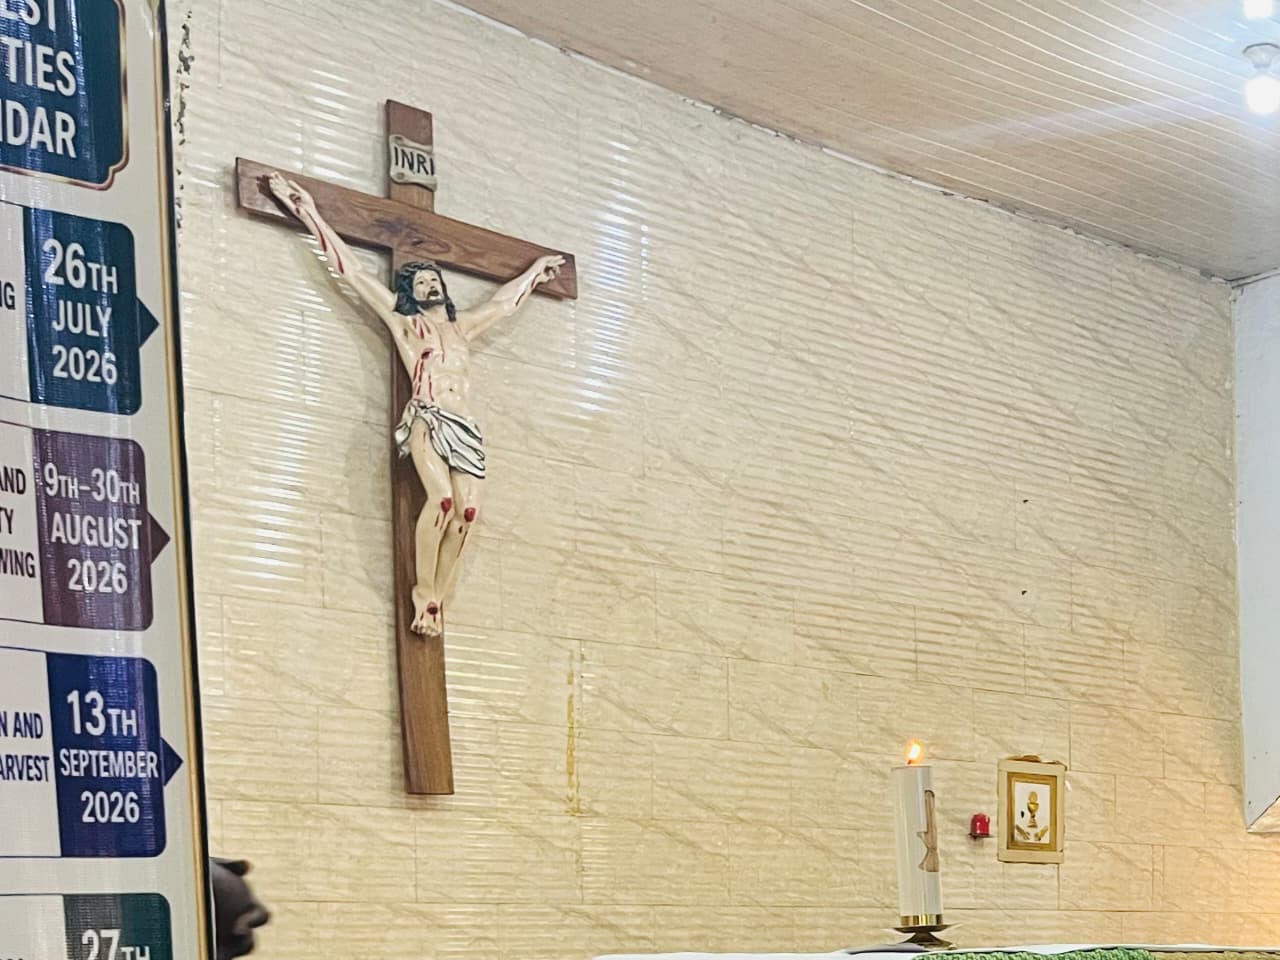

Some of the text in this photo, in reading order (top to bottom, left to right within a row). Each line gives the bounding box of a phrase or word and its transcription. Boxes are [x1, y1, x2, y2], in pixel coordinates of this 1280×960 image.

[0, 33, 77, 97] TIES
[0, 97, 77, 158] DAR
[394, 146, 435, 176] INRI
[42, 238, 118, 294] 26TH
[0, 279, 16, 310] G
[51, 299, 112, 338] JULY
[52, 344, 118, 385] 2026
[51, 512, 142, 550] AUGUST
[67, 558, 128, 594] 2026
[13, 712, 43, 739] AND
[67, 690, 138, 736] 13TH
[60, 748, 159, 778] SEPTEMBER
[81, 791, 140, 823] 2026
